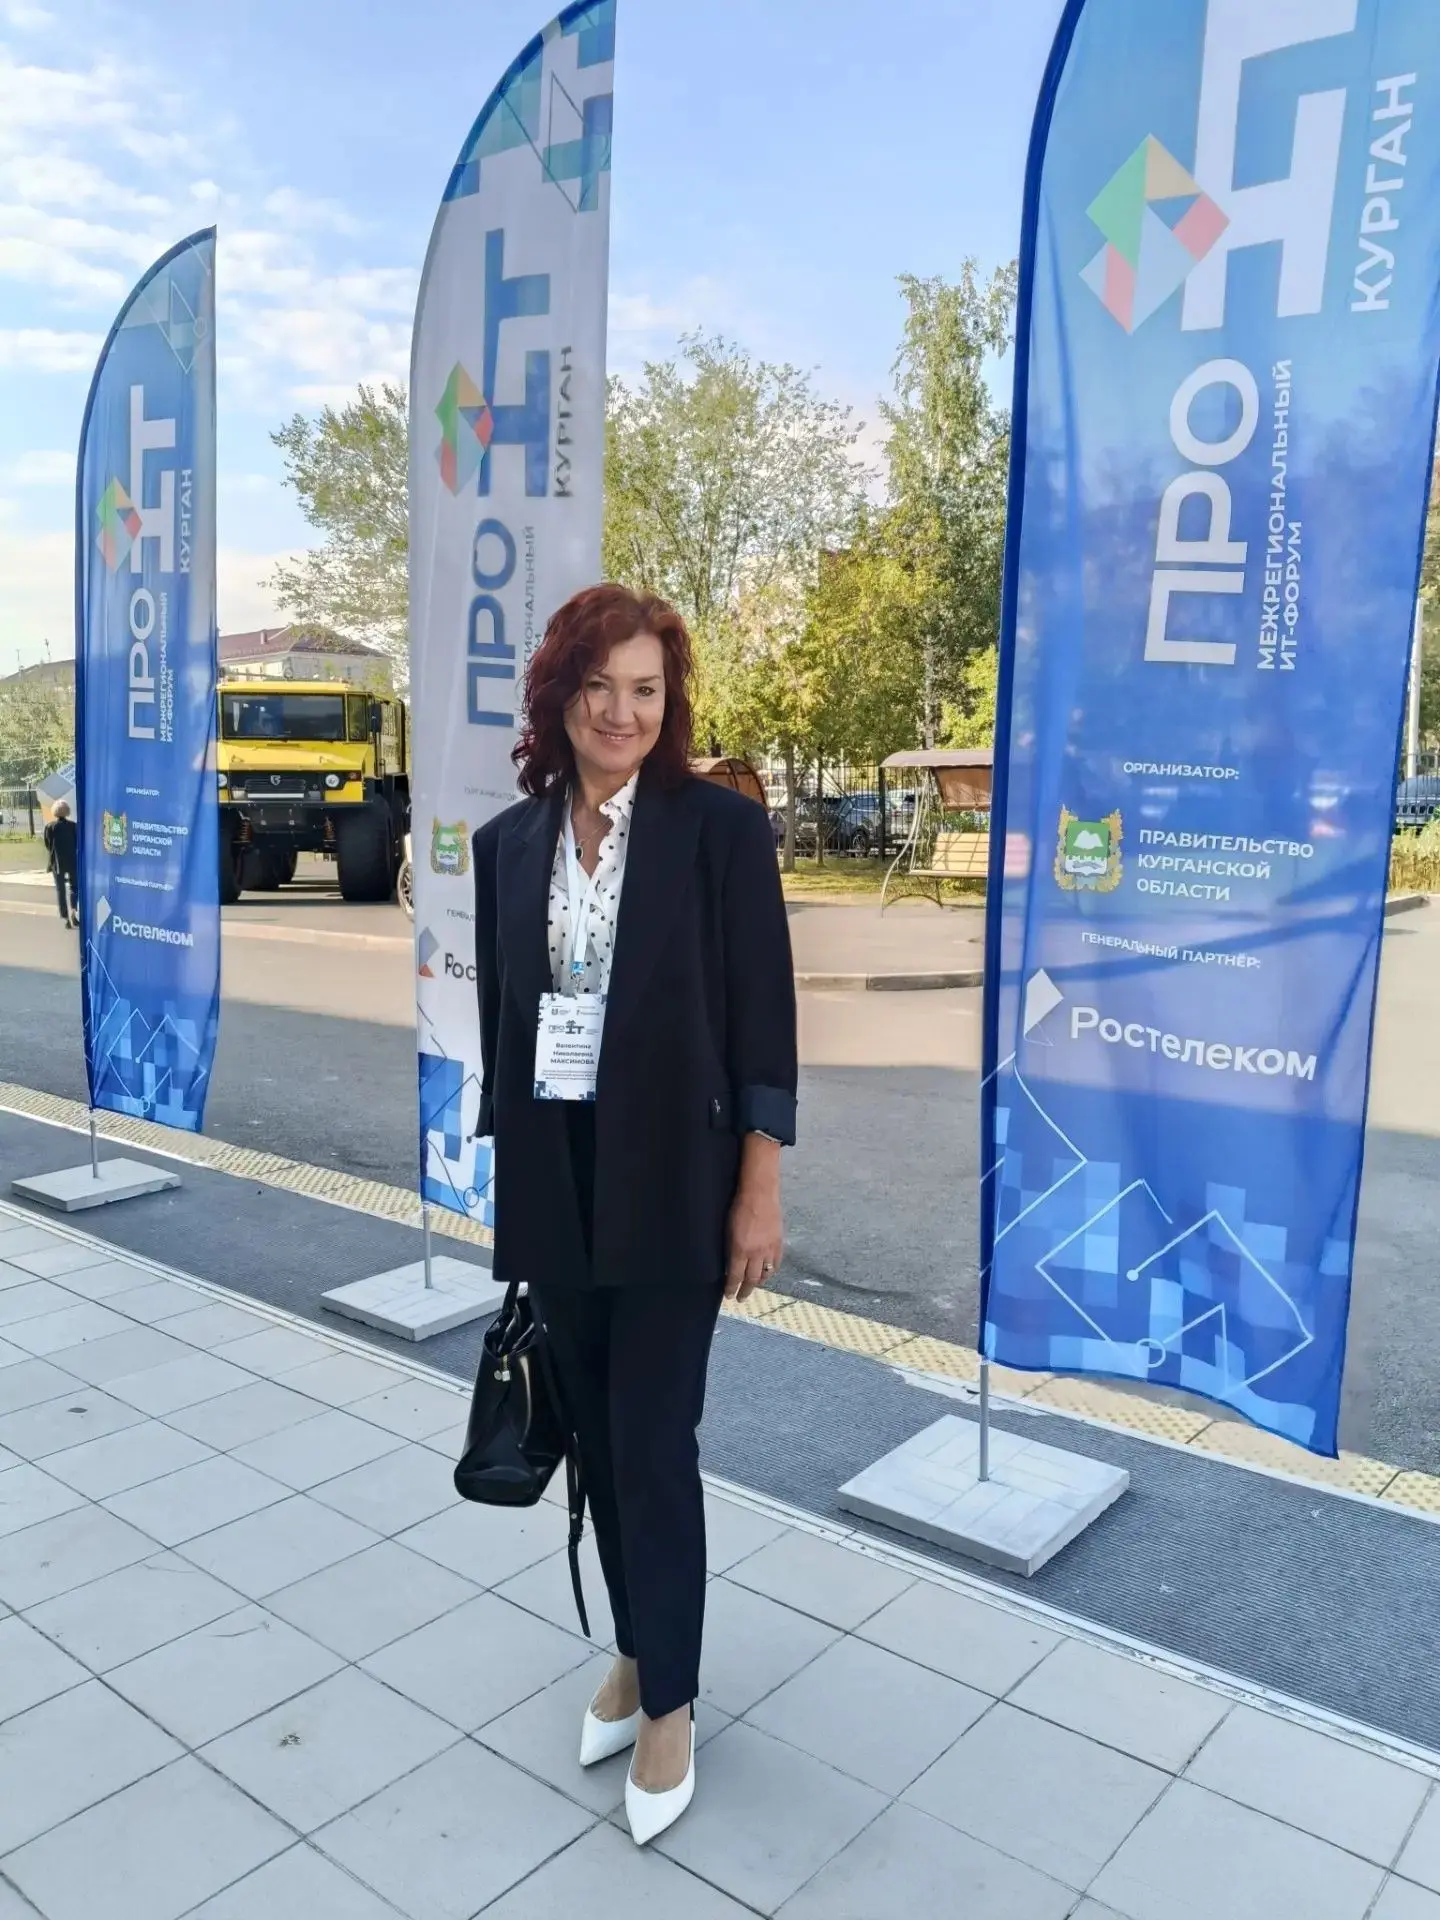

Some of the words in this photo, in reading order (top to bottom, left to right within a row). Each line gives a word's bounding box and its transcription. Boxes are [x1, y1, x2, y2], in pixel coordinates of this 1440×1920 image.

[1351, 72, 1416, 312] КУРГАН
[554, 346, 573, 498] КУРГАН
[180, 469, 193, 573] КУРГАН
[1144, 359, 1259, 665] ПРО
[1257, 359, 1292, 670] МЕЖРЕГИОНАЛЬНЫЙ
[467, 518, 517, 728] ПРО
[1279, 521, 1302, 671] ИТ-ФОРУМ
[129, 588, 155, 740] ПРО
[1123, 761, 1240, 780] ОРГАНИЗАТОР:
[1136, 878, 1231, 901] ОБЛАСТИ
[1137, 855, 1271, 880] КУРГАНСКОЙ
[1139, 829, 1315, 858] ПРАВИТЕЛЬСТВО
[112, 915, 194, 948] Ростелеком
[1081, 932, 1178, 960] ГЕНЕРАЛЬНЫЙ
[1182, 949, 1261, 969] ПАРТНЁР:
[1070, 1006, 1317, 1081] Ростелеком
